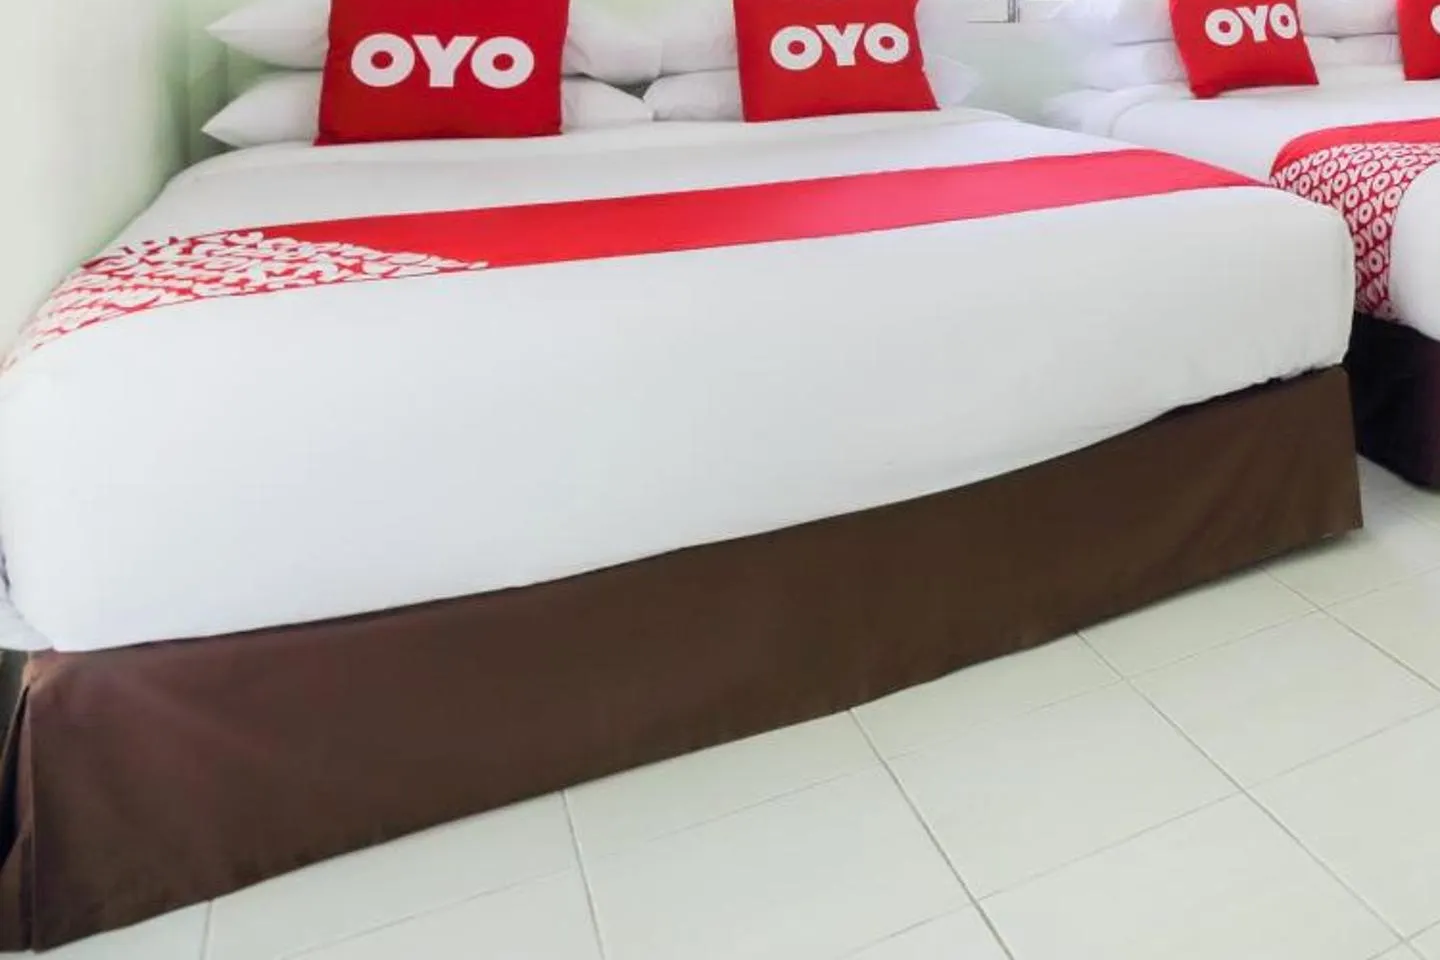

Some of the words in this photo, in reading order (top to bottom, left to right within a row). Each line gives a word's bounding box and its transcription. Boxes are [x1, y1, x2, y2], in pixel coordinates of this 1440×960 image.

[770, 22, 910, 71] OYO
[1204, 3, 1299, 47] OYO
[350, 32, 535, 89] OYO
